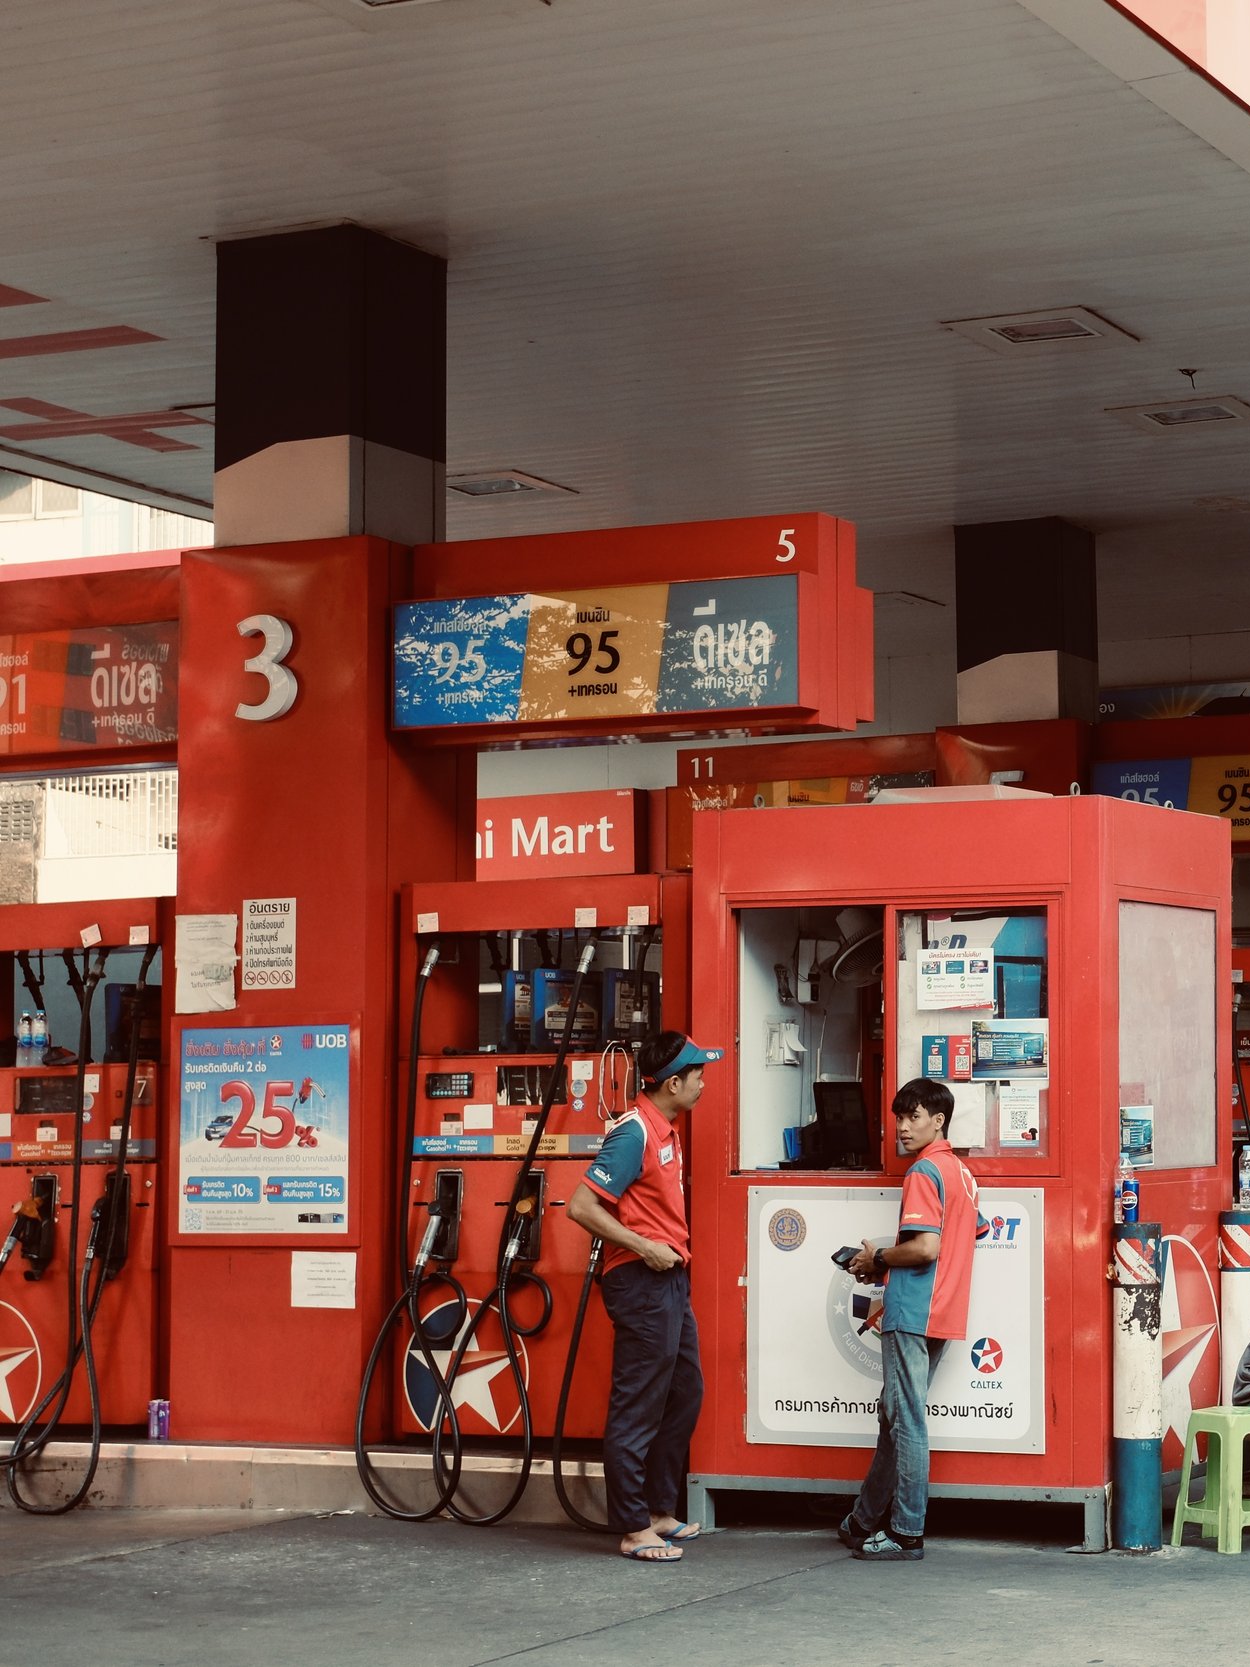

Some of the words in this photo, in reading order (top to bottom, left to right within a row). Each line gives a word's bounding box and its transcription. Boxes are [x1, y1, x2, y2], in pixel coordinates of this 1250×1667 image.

[775, 529, 796, 563] 5
[576, 607, 611, 624] เบนซิน
[693, 598, 770, 668] ดีเซล
[435, 639, 488, 684] 95
[566, 630, 620, 677] 95
[91, 643, 157, 708] ดีเซล
[235, 614, 299, 722] 3
[568, 682, 618, 697] +เทครอน
[147, 708, 155, 726] ดี
[691, 756, 714, 778] 11
[1224, 766, 1250, 779] เบนซิน
[1120, 770, 1160, 784] แก๊สโซฮอล์
[511, 815, 615, 858] Mart
[249, 902, 290, 913] อันตราย
[316, 1034, 347, 1048] UOB
[246, 1062, 253, 1072] 2
[255, 1061, 267, 1073] ต่อ
[136, 1080, 147, 1098] 7
[185, 1081, 206, 1093] สูงสุด
[231, 1183, 254, 1198] 10%
[318, 1183, 341, 1198] 15%
[842, 1331, 860, 1354] Fuel
[970, 1380, 1003, 1389] CALTEX
